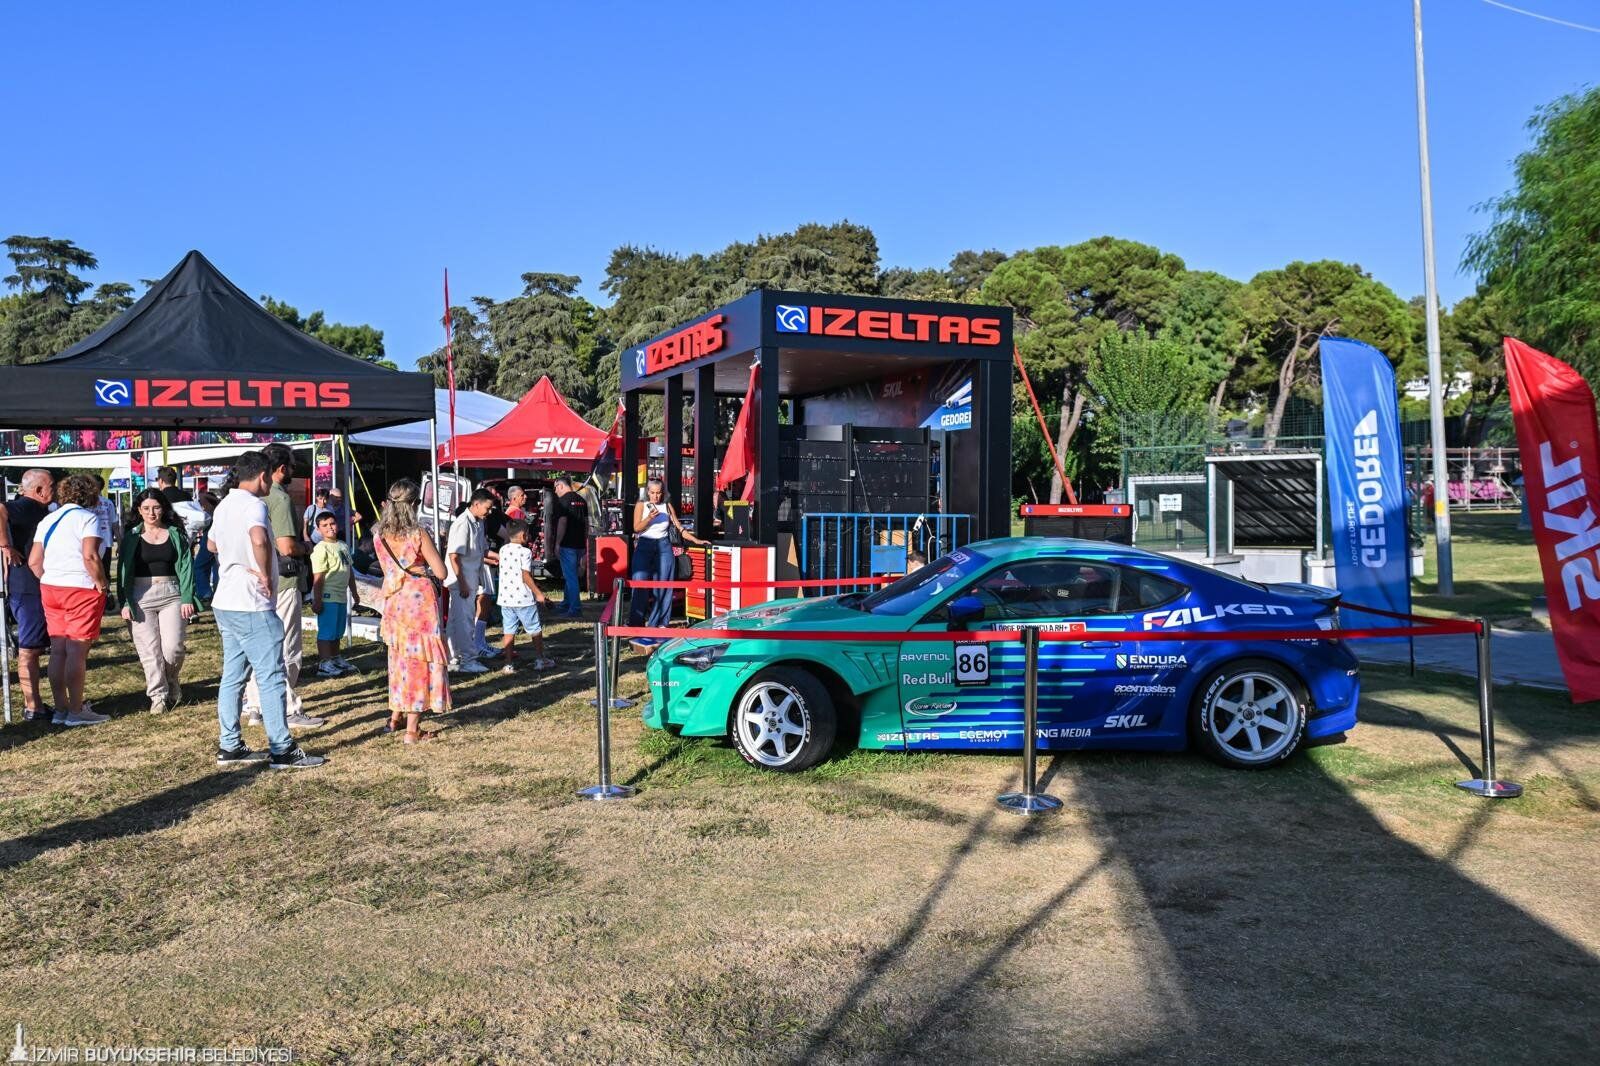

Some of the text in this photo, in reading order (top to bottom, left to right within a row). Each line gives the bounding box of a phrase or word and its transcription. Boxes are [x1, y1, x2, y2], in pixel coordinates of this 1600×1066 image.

[810, 307, 1001, 345] IZELTAS
[135, 379, 350, 408] IZELTAS
[882, 381, 903, 397] SKIL
[532, 437, 585, 454] SKIL
[900, 653, 950, 662] RAVENOL
[959, 653, 987, 673] 86
[1129, 654, 1187, 664] ENDURA
[903, 672, 952, 685] Red Bull
[1103, 714, 1148, 729] SKIL
[959, 729, 1009, 739] EGEMOT
[1060, 728, 1092, 738] MEDIA
